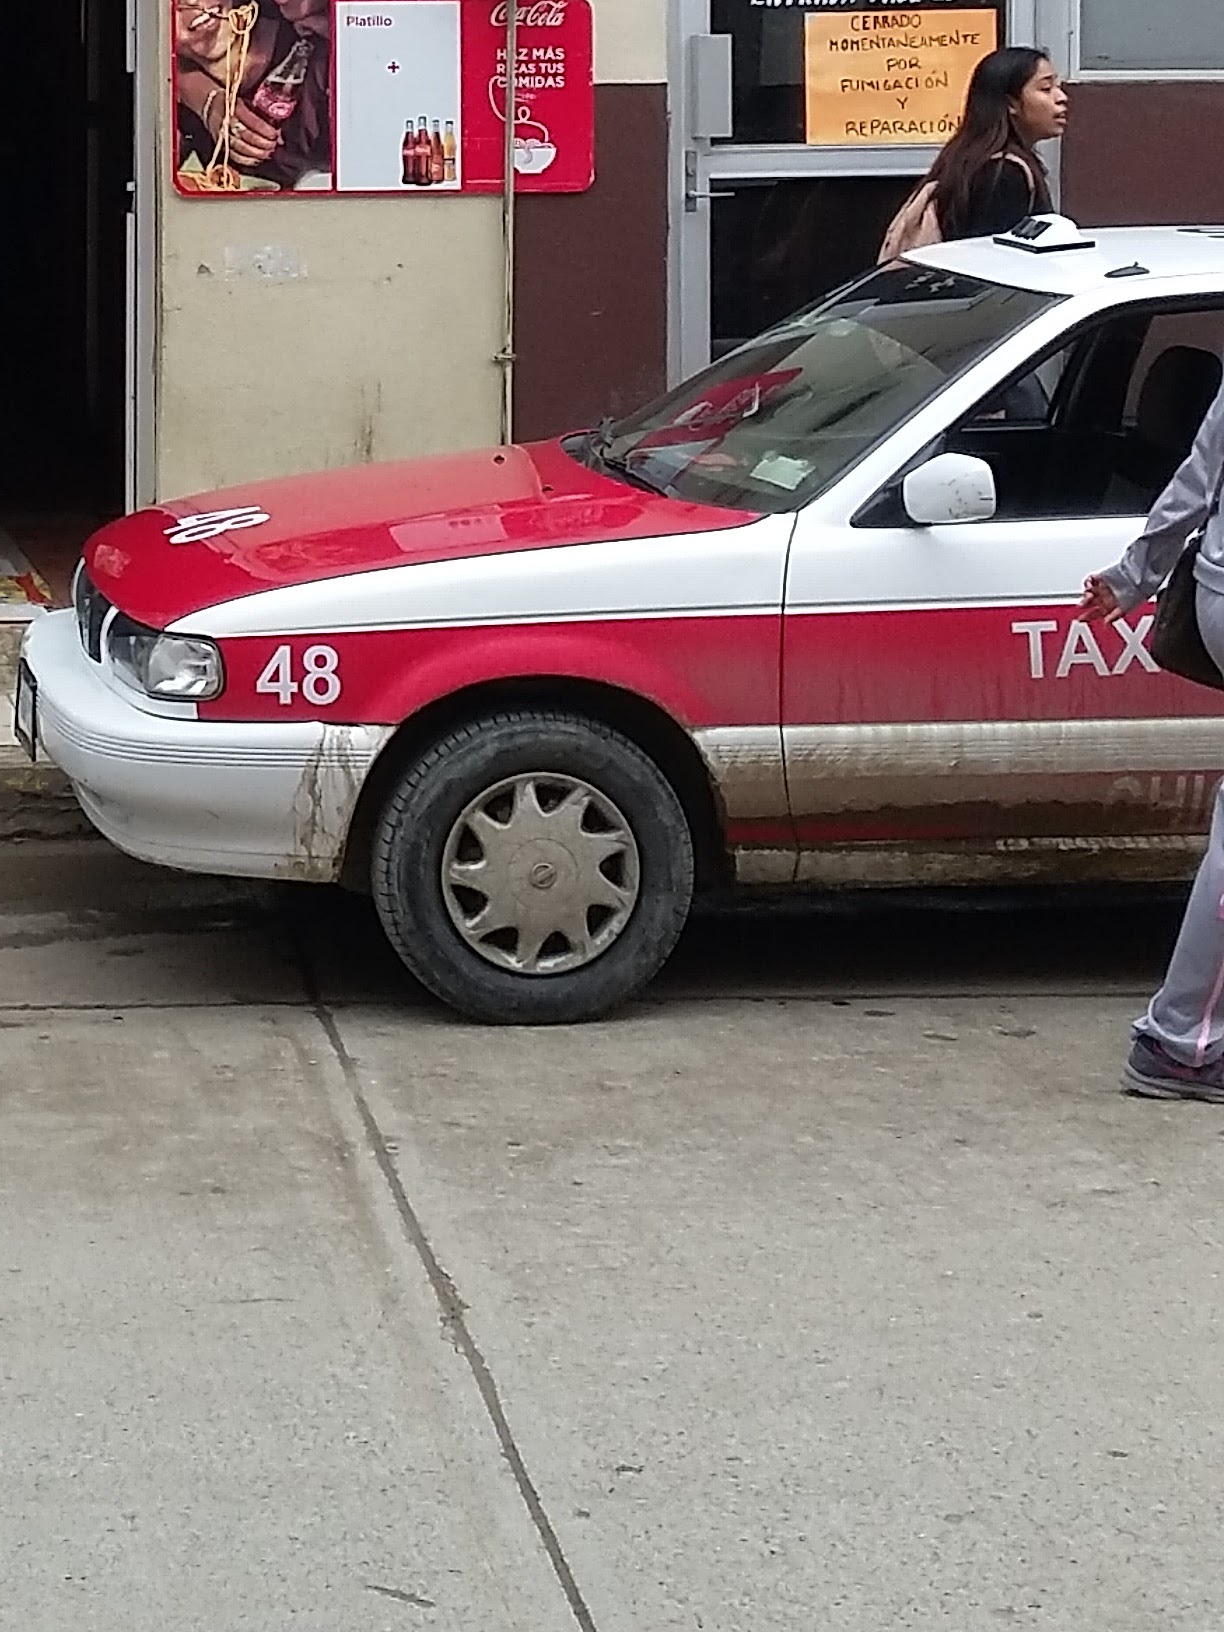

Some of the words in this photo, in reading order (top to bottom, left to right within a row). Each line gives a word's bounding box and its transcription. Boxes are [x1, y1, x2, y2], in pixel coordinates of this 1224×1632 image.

[490, 0, 568, 26] Ca-Cola
[346, 16, 392, 27] Platillo
[851, 13, 922, 32] CERRADO
[829, 30, 981, 51] MOMENTANEAMENTE
[496, 48, 528, 60] HZ
[496, 63, 536, 74] RAS
[538, 62, 565, 74] TUS
[887, 57, 922, 71] POR
[897, 96, 908, 110] Y
[1011, 614, 1163, 679] TAX
[255, 644, 342, 706] 48
